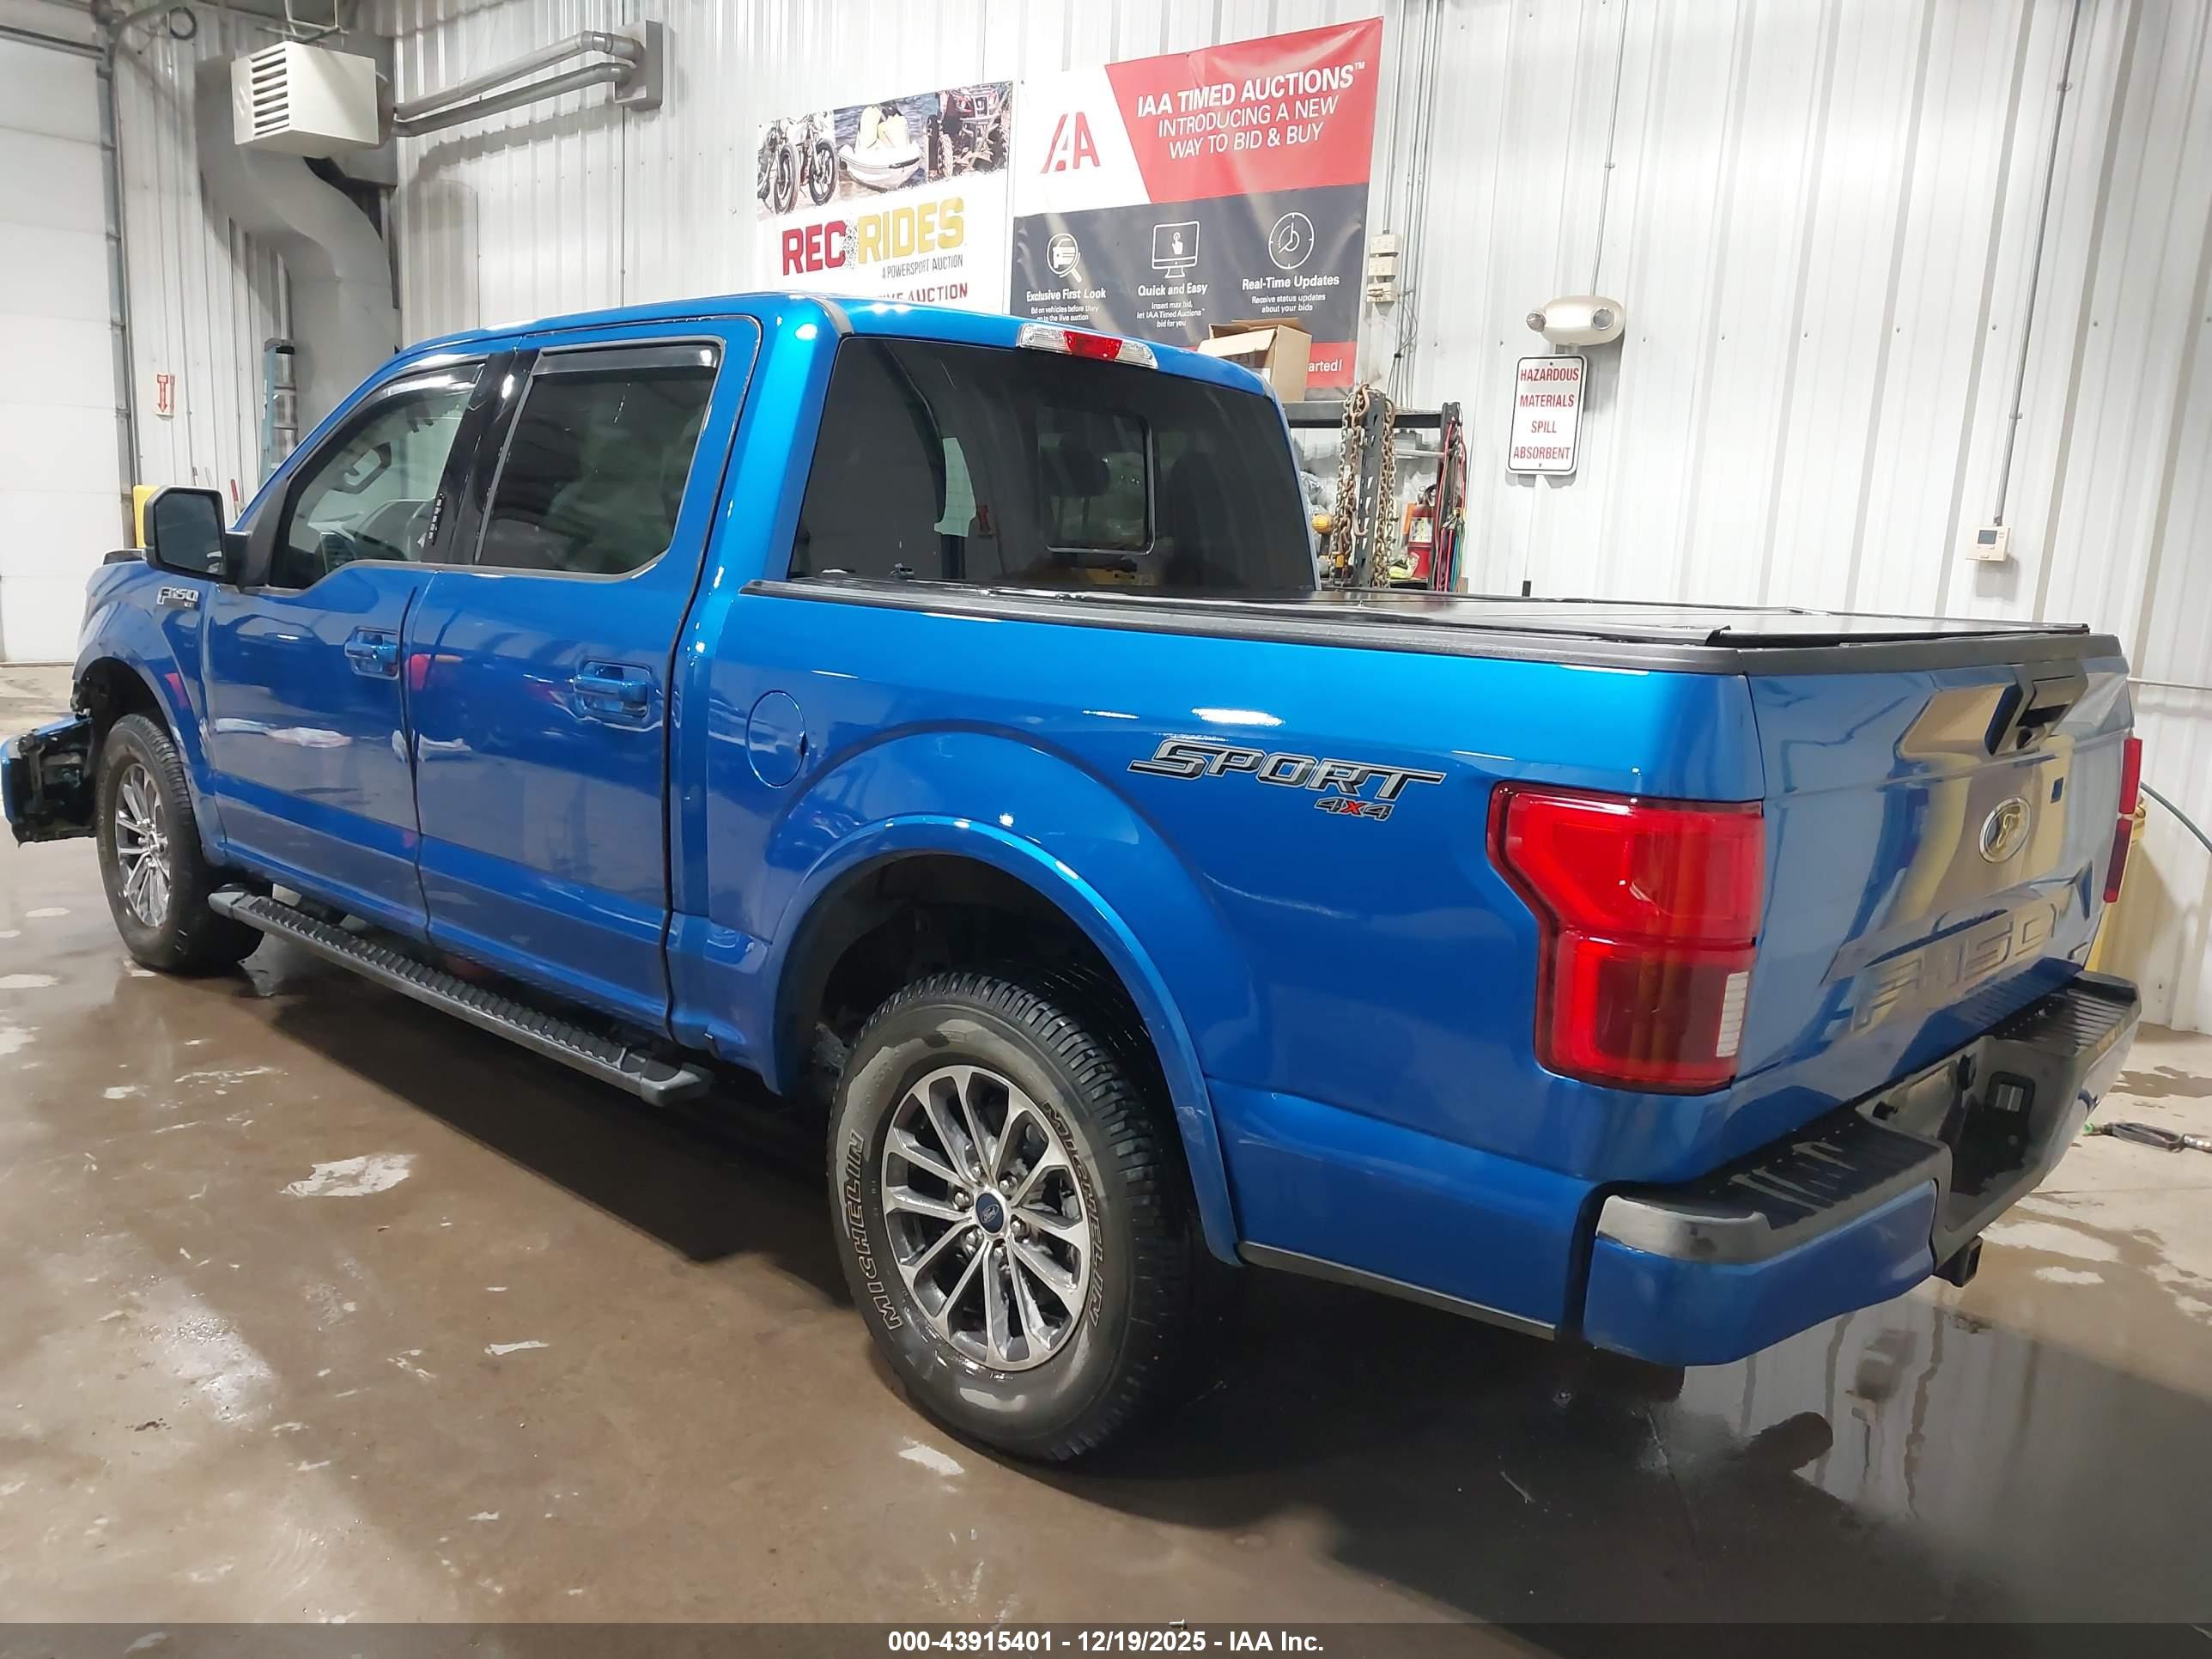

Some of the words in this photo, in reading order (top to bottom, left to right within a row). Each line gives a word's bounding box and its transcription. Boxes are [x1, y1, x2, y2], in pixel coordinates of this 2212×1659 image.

[1137, 93, 1173, 118] IAA
[1177, 83, 1236, 112] TIMED
[1158, 104, 1270, 137] INTRODUCING
[1276, 102, 1290, 121] A
[1295, 94, 1340, 119] NEW
[1169, 136, 1204, 160] WAY
[1208, 134, 1228, 154] TO
[1233, 130, 1262, 151] BID
[1267, 128, 1281, 148] &
[1286, 121, 1324, 144] BUY
[782, 220, 847, 276] REC
[858, 197, 965, 264] RIDES
[887, 258, 930, 279] POWERSPORT
[932, 254, 963, 272] AUCTION
[1138, 284, 1166, 296] Quick
[1167, 283, 1185, 295] and
[1186, 282, 1208, 295] Easy
[1242, 276, 1291, 291] Real-Time
[1293, 275, 1340, 289] Updates
[908, 282, 968, 303] AUCTION
[1026, 289, 1060, 302] Exclusive
[1062, 288, 1081, 300] First
[1083, 287, 1107, 299] Look
[1251, 295, 1276, 304] Receive
[1276, 295, 1297, 303] status
[1297, 293, 1326, 302] updates
[1067, 304, 1084, 313] before
[1152, 301, 1169, 310] Insert
[1261, 305, 1280, 313] about
[1280, 304, 1297, 313] your
[1297, 303, 1313, 312] bids
[1520, 368, 1580, 382] HAZARDOUS
[1519, 393, 1575, 408] MATERIALS
[1530, 420, 1557, 434] SPILL
[1513, 446, 1571, 460] ABSORBENT
[1127, 738, 1447, 801] SPORT
[1042, 1100, 1104, 1328] MICHELIN
[845, 1128, 902, 1331] MICHELIN
